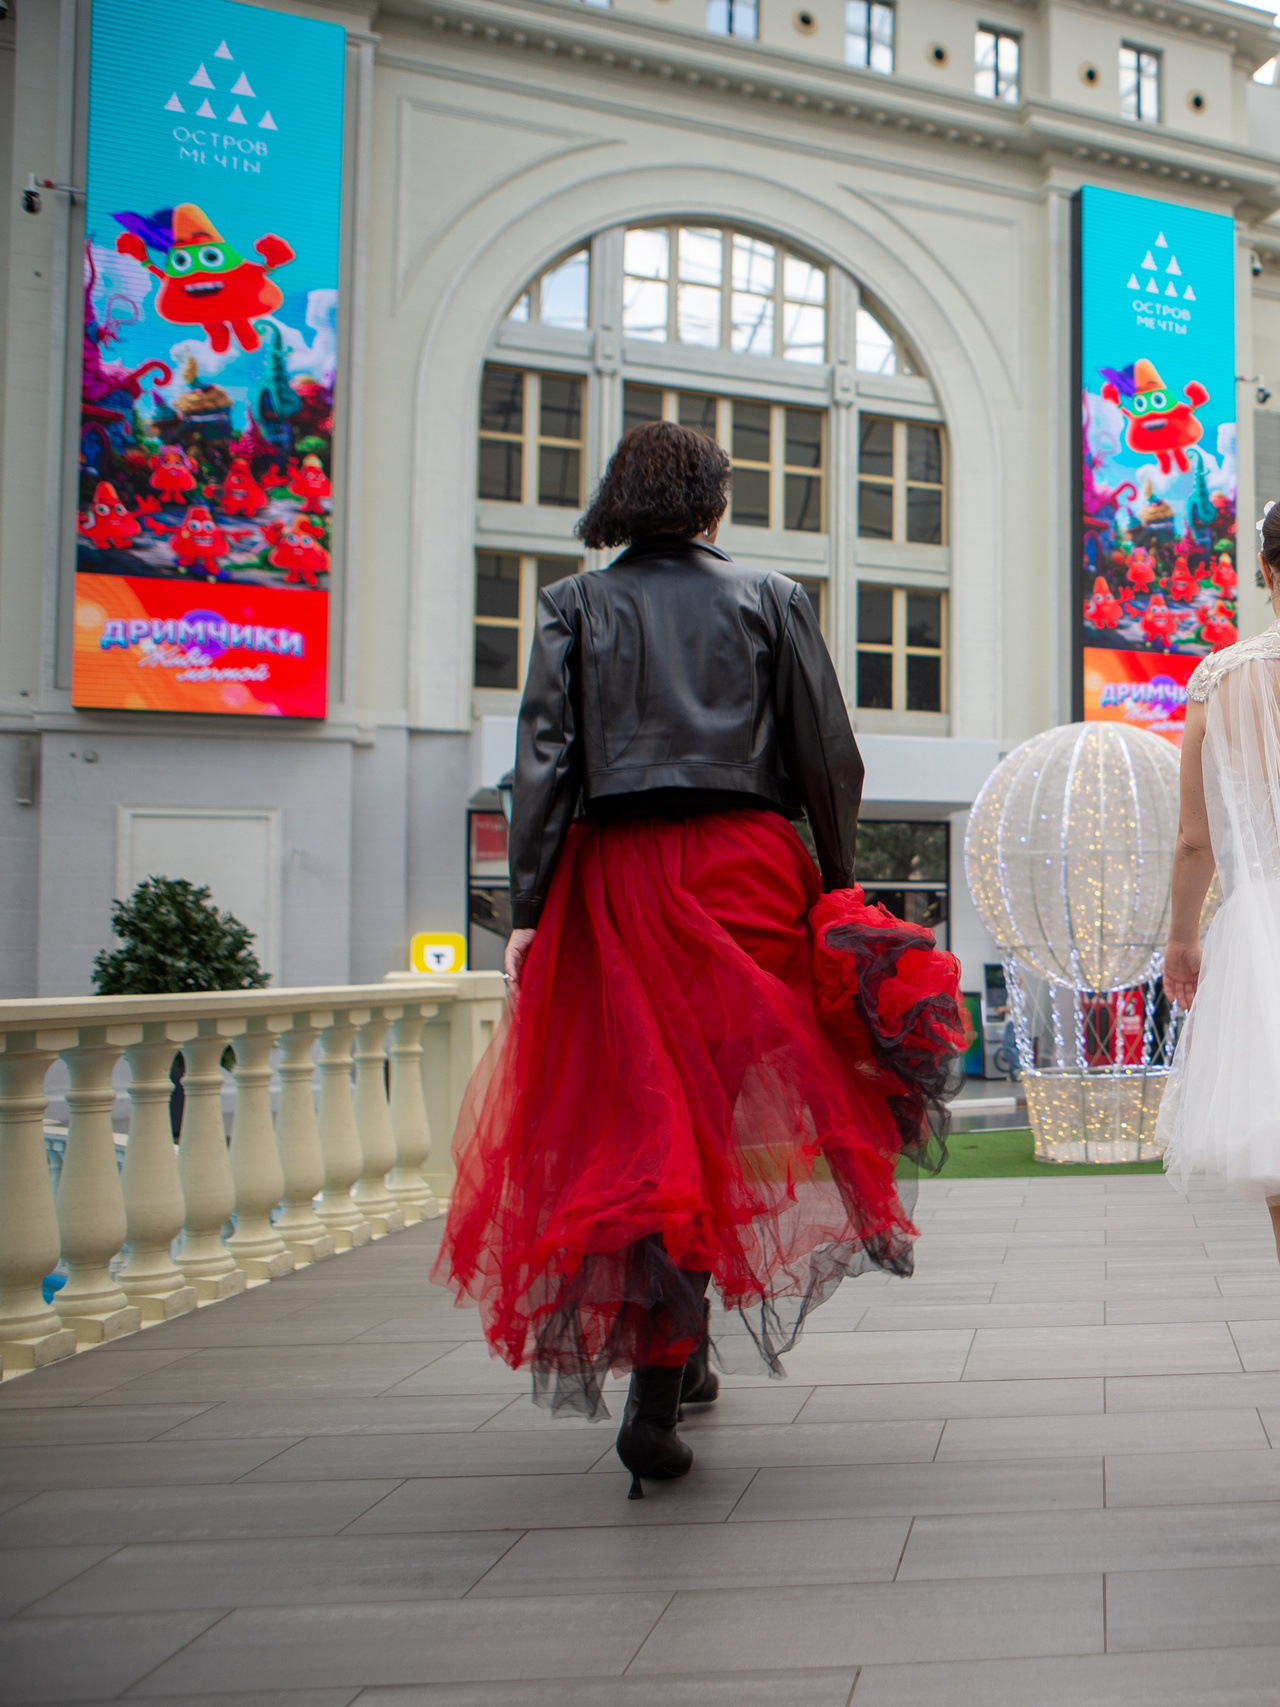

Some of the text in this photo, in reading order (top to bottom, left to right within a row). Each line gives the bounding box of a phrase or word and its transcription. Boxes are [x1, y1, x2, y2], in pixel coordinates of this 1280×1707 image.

[173, 127, 268, 156] ОСТРОВ
[1132, 300, 1191, 321] ОСТРОВ
[1136, 315, 1187, 335] МЕЧТЫ
[101, 619, 303, 657] ДРИМЧИКИ
[1101, 684, 1187, 707] ДРИМЧИ
